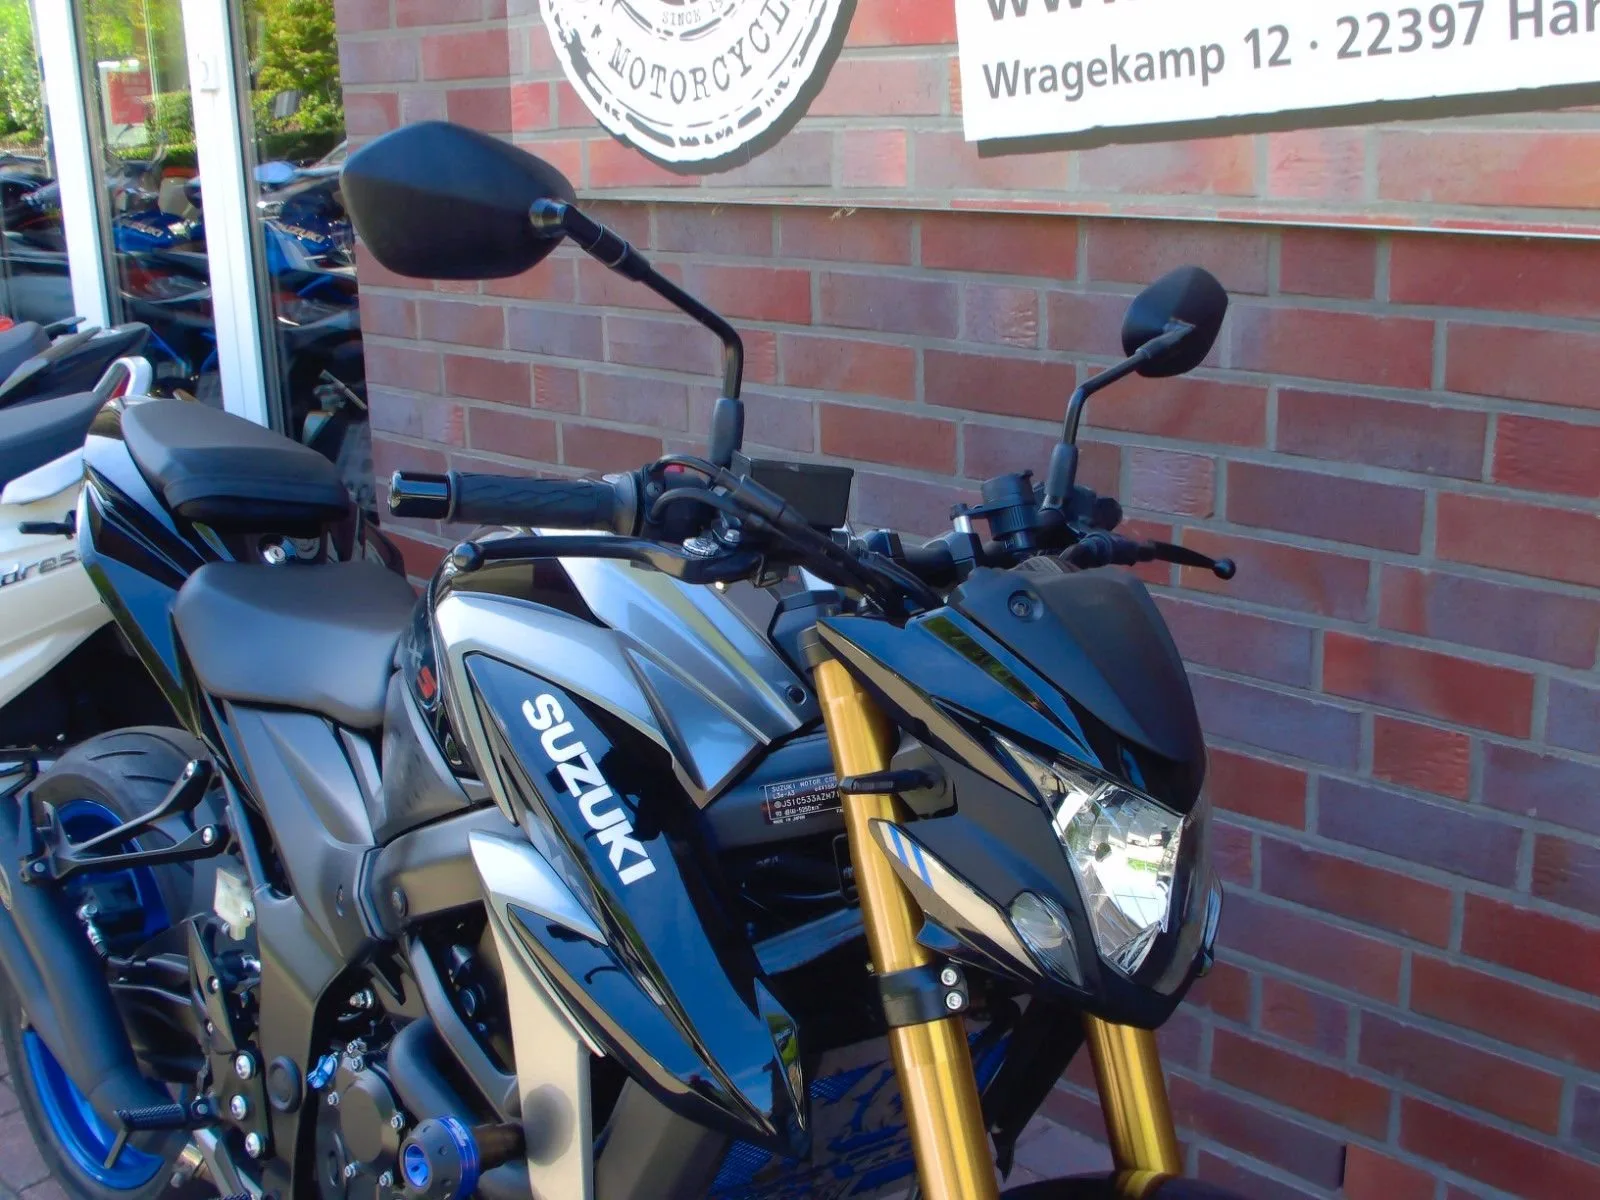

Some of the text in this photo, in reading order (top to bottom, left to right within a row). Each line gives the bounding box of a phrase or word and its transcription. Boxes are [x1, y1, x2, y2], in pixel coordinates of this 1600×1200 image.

[608, 0, 790, 105] MOTORCYCL
[982, 43, 1226, 102] Wragekamp
[1243, 24, 1292, 69] 12
[1335, 0, 1485, 60] 22397
[0, 550, 78, 588] dres
[521, 693, 657, 886] SUZUKI
[771, 783, 796, 793] SUZUKI
